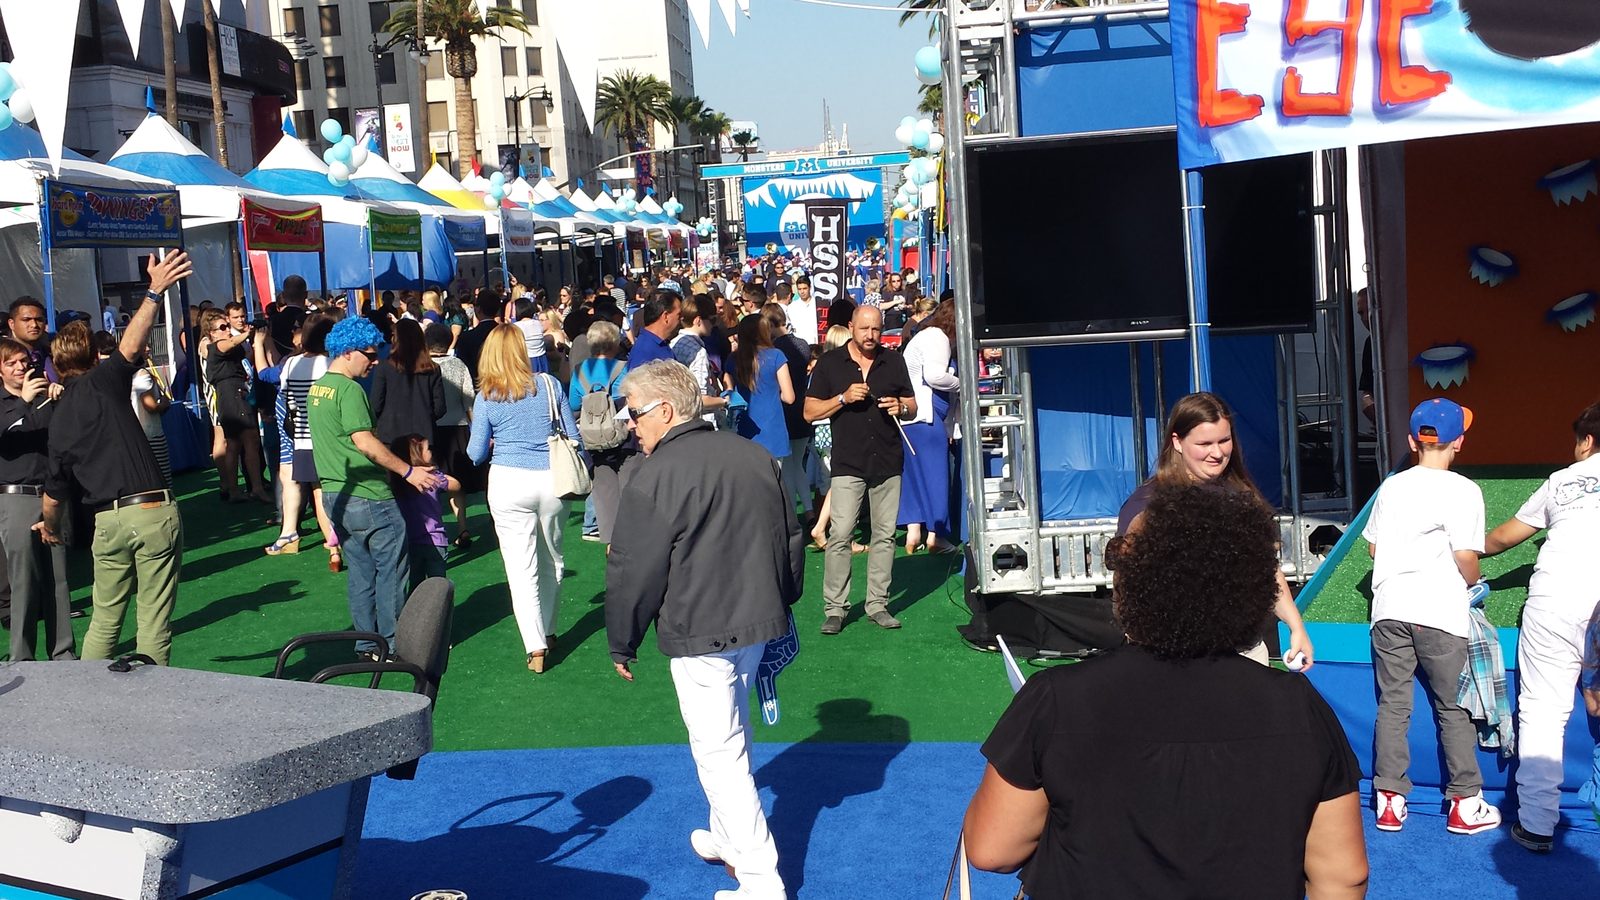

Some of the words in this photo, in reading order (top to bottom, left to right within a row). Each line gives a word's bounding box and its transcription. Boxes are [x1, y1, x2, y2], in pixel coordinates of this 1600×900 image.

[1197, 0, 1453, 128] EYE
[391, 145, 410, 153] NOW
[743, 163, 785, 174] MONSTERS
[826, 157, 873, 167] UNIVERSITY
